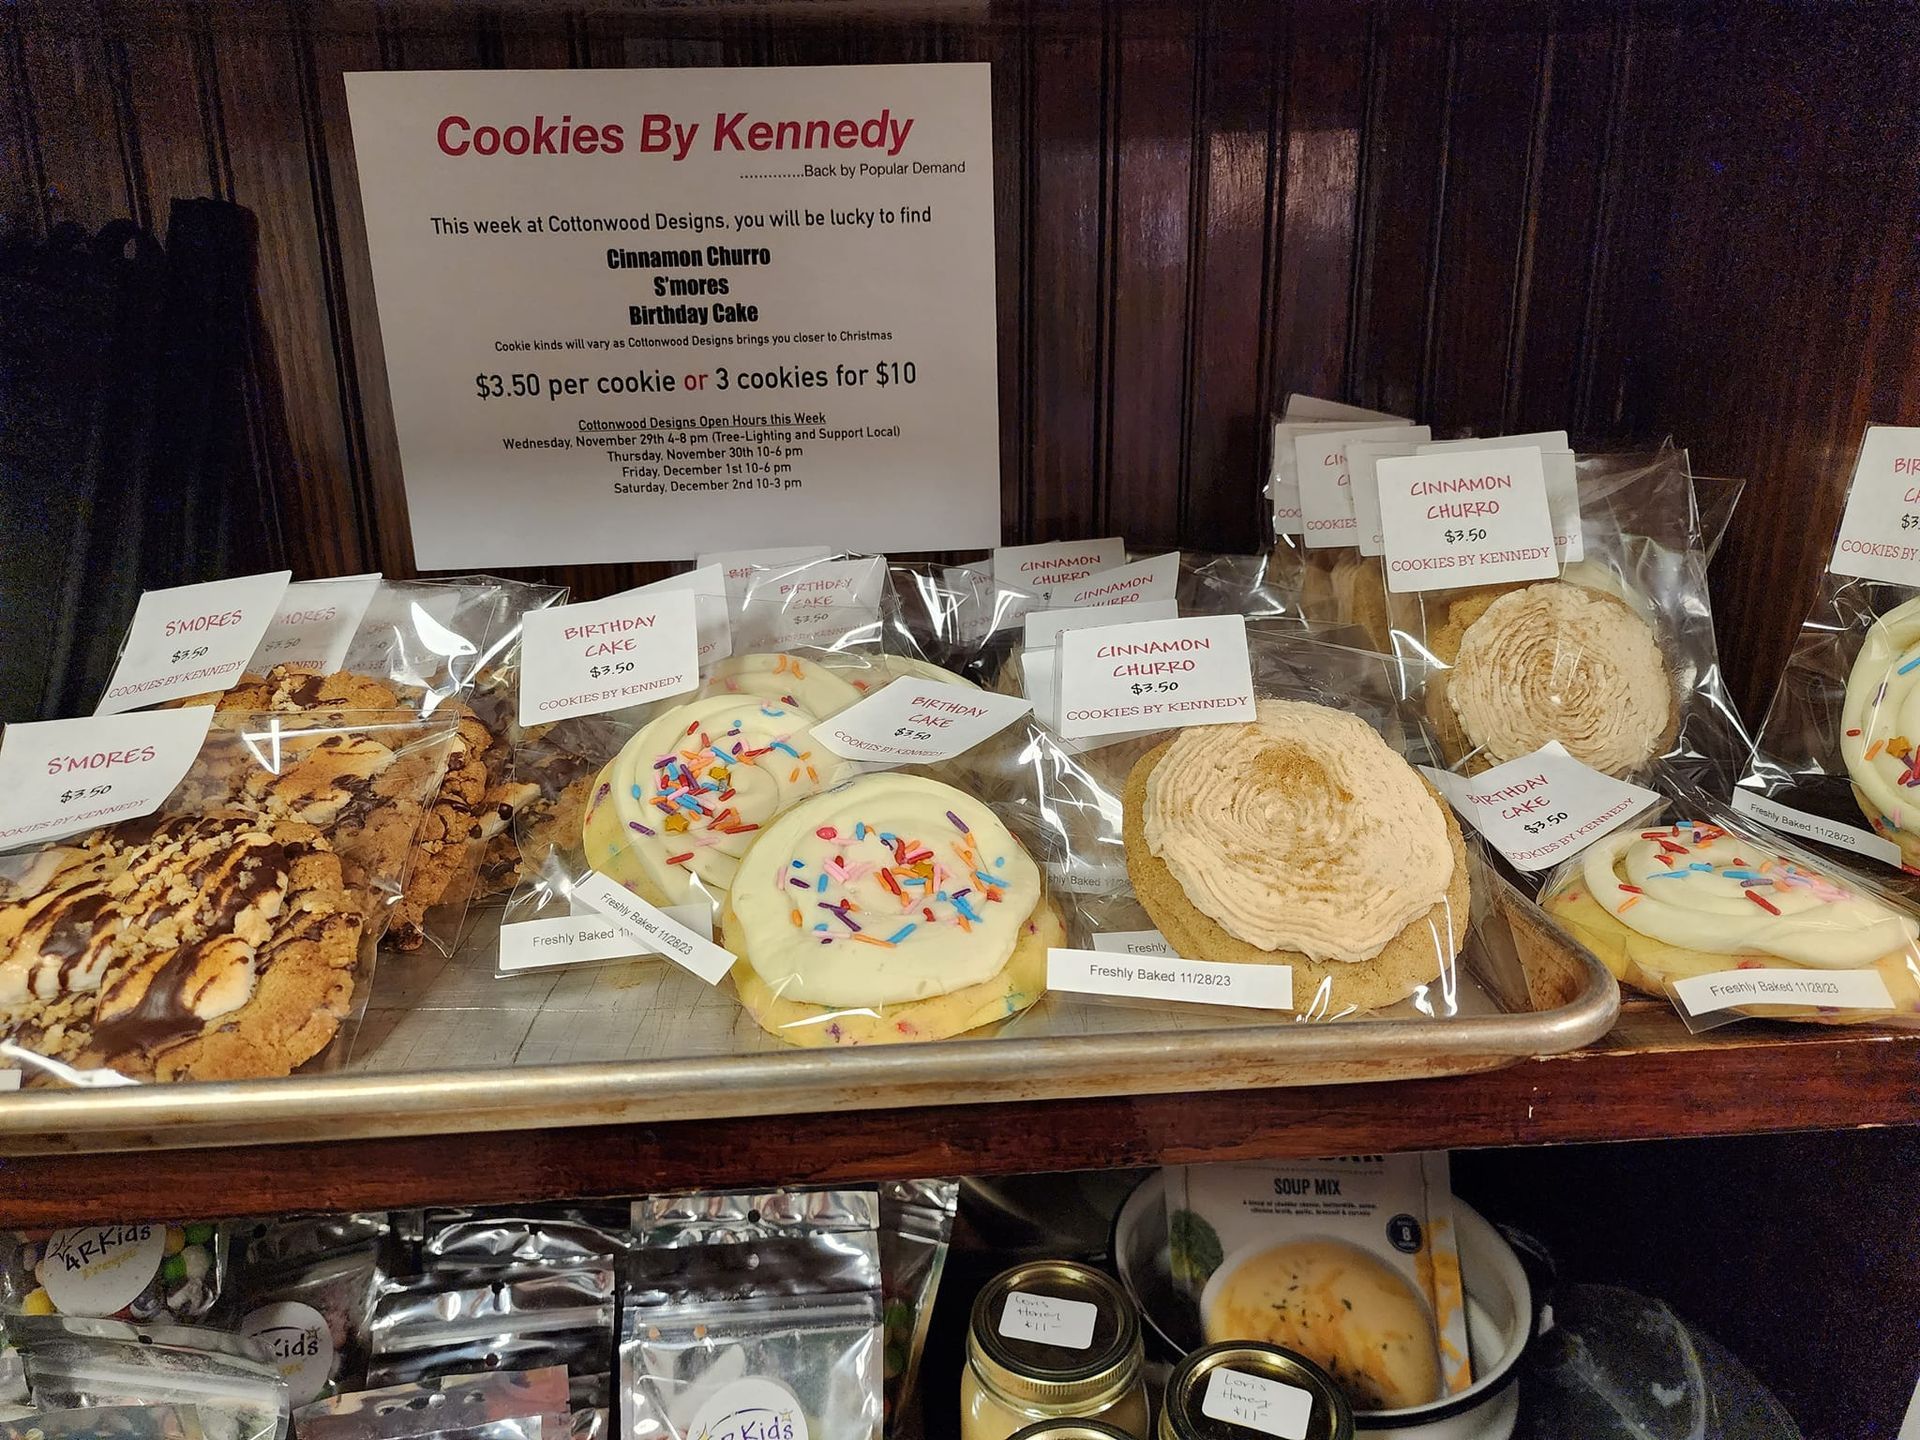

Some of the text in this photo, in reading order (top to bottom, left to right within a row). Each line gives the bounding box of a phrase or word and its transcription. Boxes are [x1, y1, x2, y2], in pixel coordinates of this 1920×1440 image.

[436, 109, 915, 162] Cookies By Kennedy
[840, 163, 857, 179] by
[860, 162, 909, 178] Popular
[912, 161, 965, 174] Demand
[430, 205, 931, 235] This week at Cottonwood Designs, you will be lucky to find
[607, 245, 771, 271] Cinnamon Churro
[653, 276, 730, 297] S'mores
[629, 300, 759, 329] Birthday Cake
[494, 330, 893, 352] Cookie kinds will vary as Cottonwood Designs brings you closer to Christmas
[476, 359, 916, 402] $3.50 per cookie or 3 cookies for $10
[578, 411, 826, 430] Cottonwood Designs Open Hours this Week
[503, 425, 900, 451] Wednesday, November 29th 4-8 pm (Tree-Lighting and Support Local)
[608, 445, 803, 463] Thursday, November 30th 10-6 pm
[622, 461, 792, 479] Friday, December 1st 10-6 pm
[614, 476, 802, 495] Saturday, December 2nd 10-3 pm
[1410, 475, 1512, 497] CINNAMON
[1426, 500, 1500, 521] CHURRO
[1307, 518, 1358, 530] COOKIES
[1444, 528, 1488, 545] $3.50
[1391, 546, 1551, 573] COOKIES BY KENNEDY
[1841, 540, 1919, 561] COOKIES BY
[1020, 555, 1101, 572] CINNAMON
[780, 578, 853, 595] BIRTHDAY
[1073, 574, 1154, 603] CINNAMON
[165, 609, 243, 637] S'MORES
[564, 615, 656, 640] BIRTHDAY
[172, 646, 209, 664] $3.50
[585, 638, 637, 657] CAKE
[1096, 638, 1211, 659] CINNAMON
[108, 677, 166, 699] COOKIES
[163, 672, 184, 686] BY
[183, 659, 248, 682] KENNEDY
[589, 662, 635, 679] $3.50
[1113, 659, 1196, 677] CHURRO
[539, 675, 684, 711] COOKIES BY KENNEDY
[1131, 681, 1179, 696] $3.50
[911, 696, 988, 718] BIRTHDAY
[1066, 696, 1249, 722] COOKIES BY KENNEDY
[908, 714, 954, 728] CAKE
[834, 730, 882, 752] COOKIES
[882, 746, 896, 755] BY
[894, 727, 932, 741] $3.50
[47, 746, 156, 775] S'MORES
[60, 785, 112, 804] $3.50
[1466, 774, 1549, 806] BIRTHDAY
[0, 798, 150, 838] OOKIES BY KENNEDY
[1502, 795, 1551, 820] CAKE
[1510, 797, 1635, 861] COOKIES BY KENNEDY
[1523, 811, 1569, 834] $3.50
[1750, 803, 1856, 845] Freshly Baked 11/28/23
[600, 893, 694, 956] Freshly Baked 11/28/23
[533, 934, 575, 947] Freshly
[578, 928, 615, 942] Baked
[1127, 943, 1167, 954] Freshly
[1090, 965, 1232, 987] Freshly Baked 11/28/23
[1709, 980, 1839, 997] Freshly Baked 11/28/23
[1274, 1177, 1342, 1196] SOUP MIX
